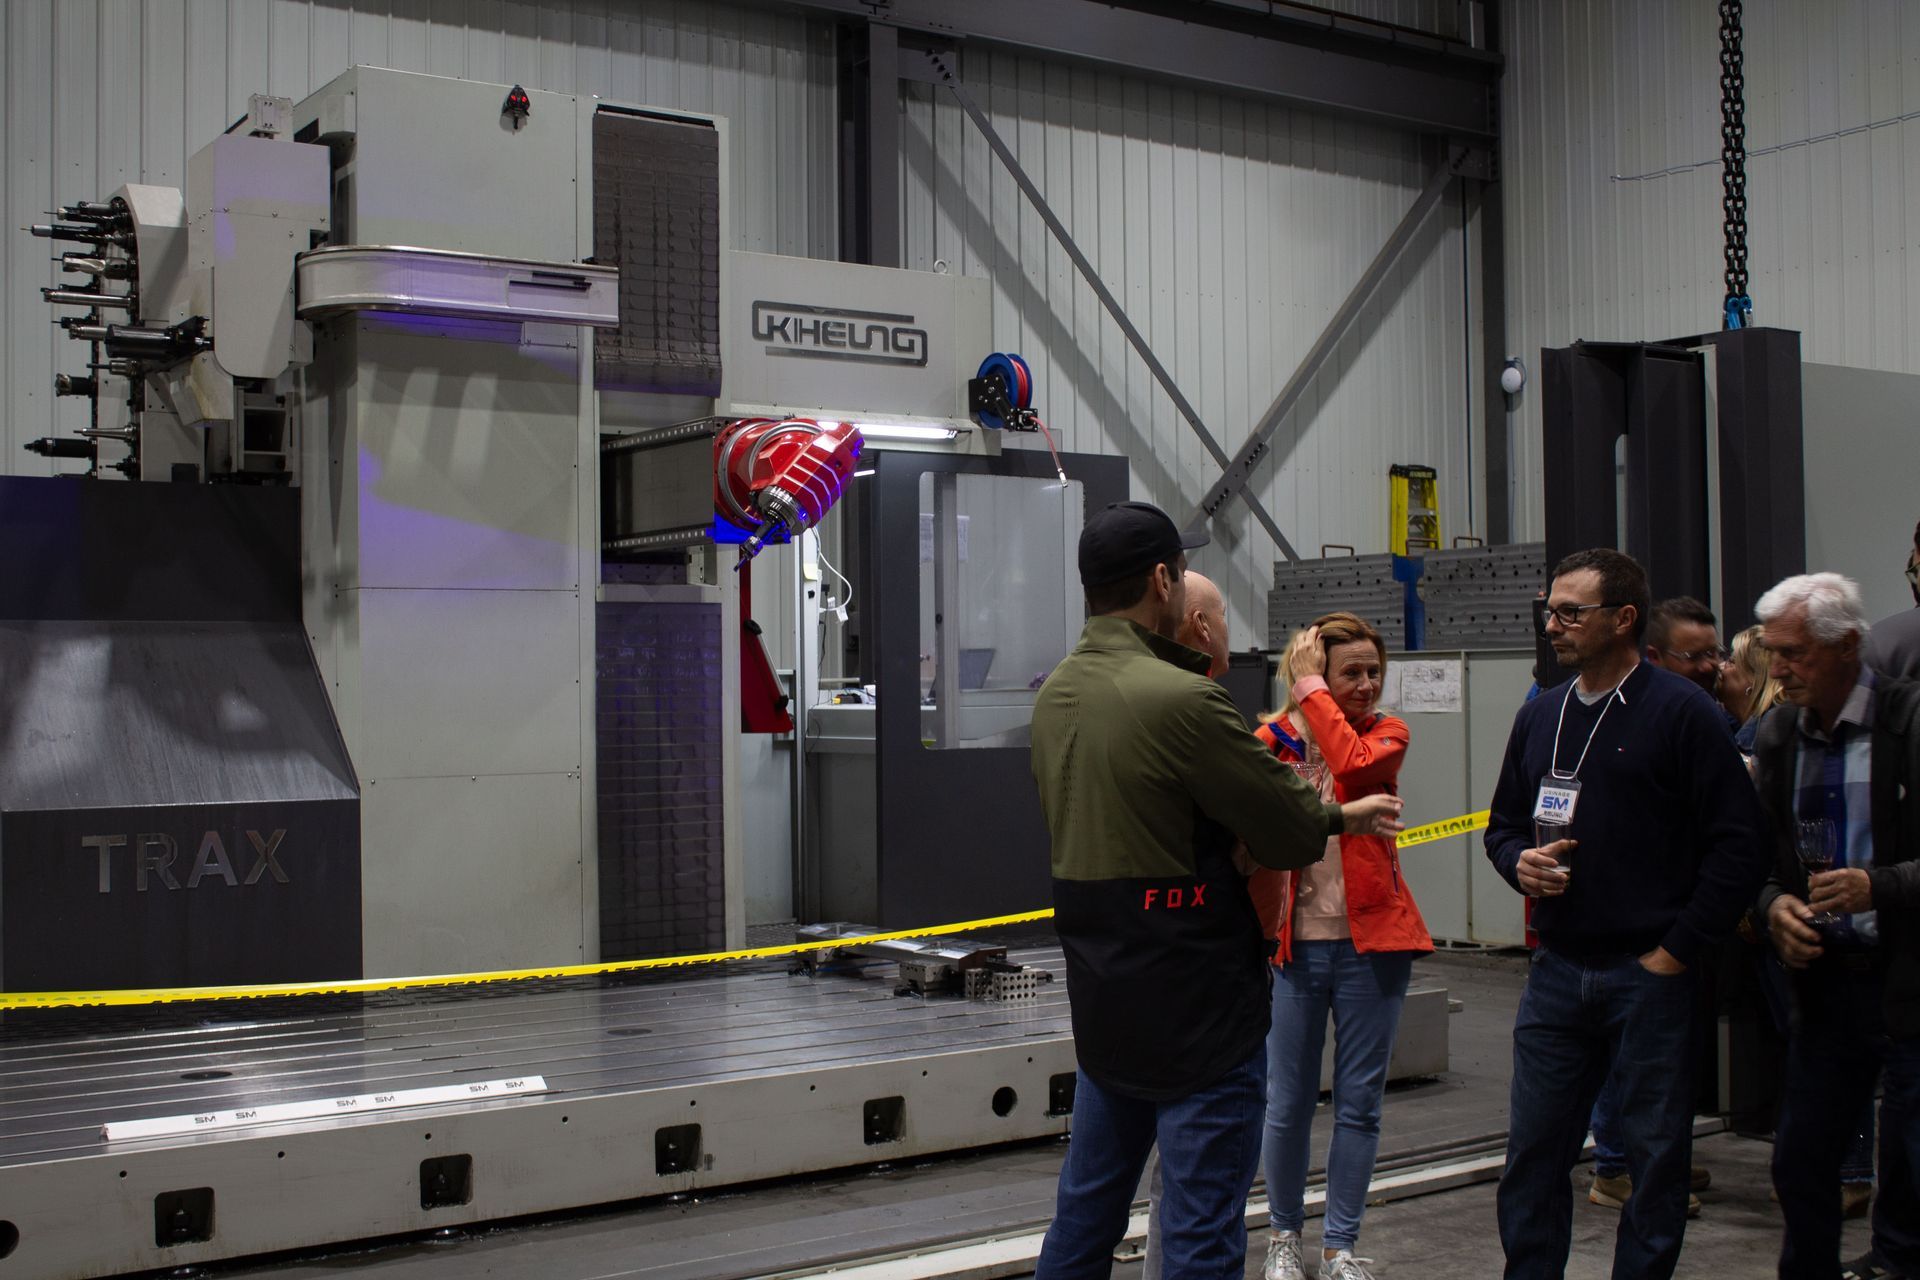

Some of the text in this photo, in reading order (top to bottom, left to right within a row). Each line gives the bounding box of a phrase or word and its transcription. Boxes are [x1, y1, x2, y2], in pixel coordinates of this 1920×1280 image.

[752, 303, 928, 364] KIHEUNG
[1541, 795, 1569, 810] SM
[81, 828, 290, 893] TRAX
[1143, 882, 1209, 911] FOX
[194, 1080, 525, 1125] SM SM SM SM SM SM
